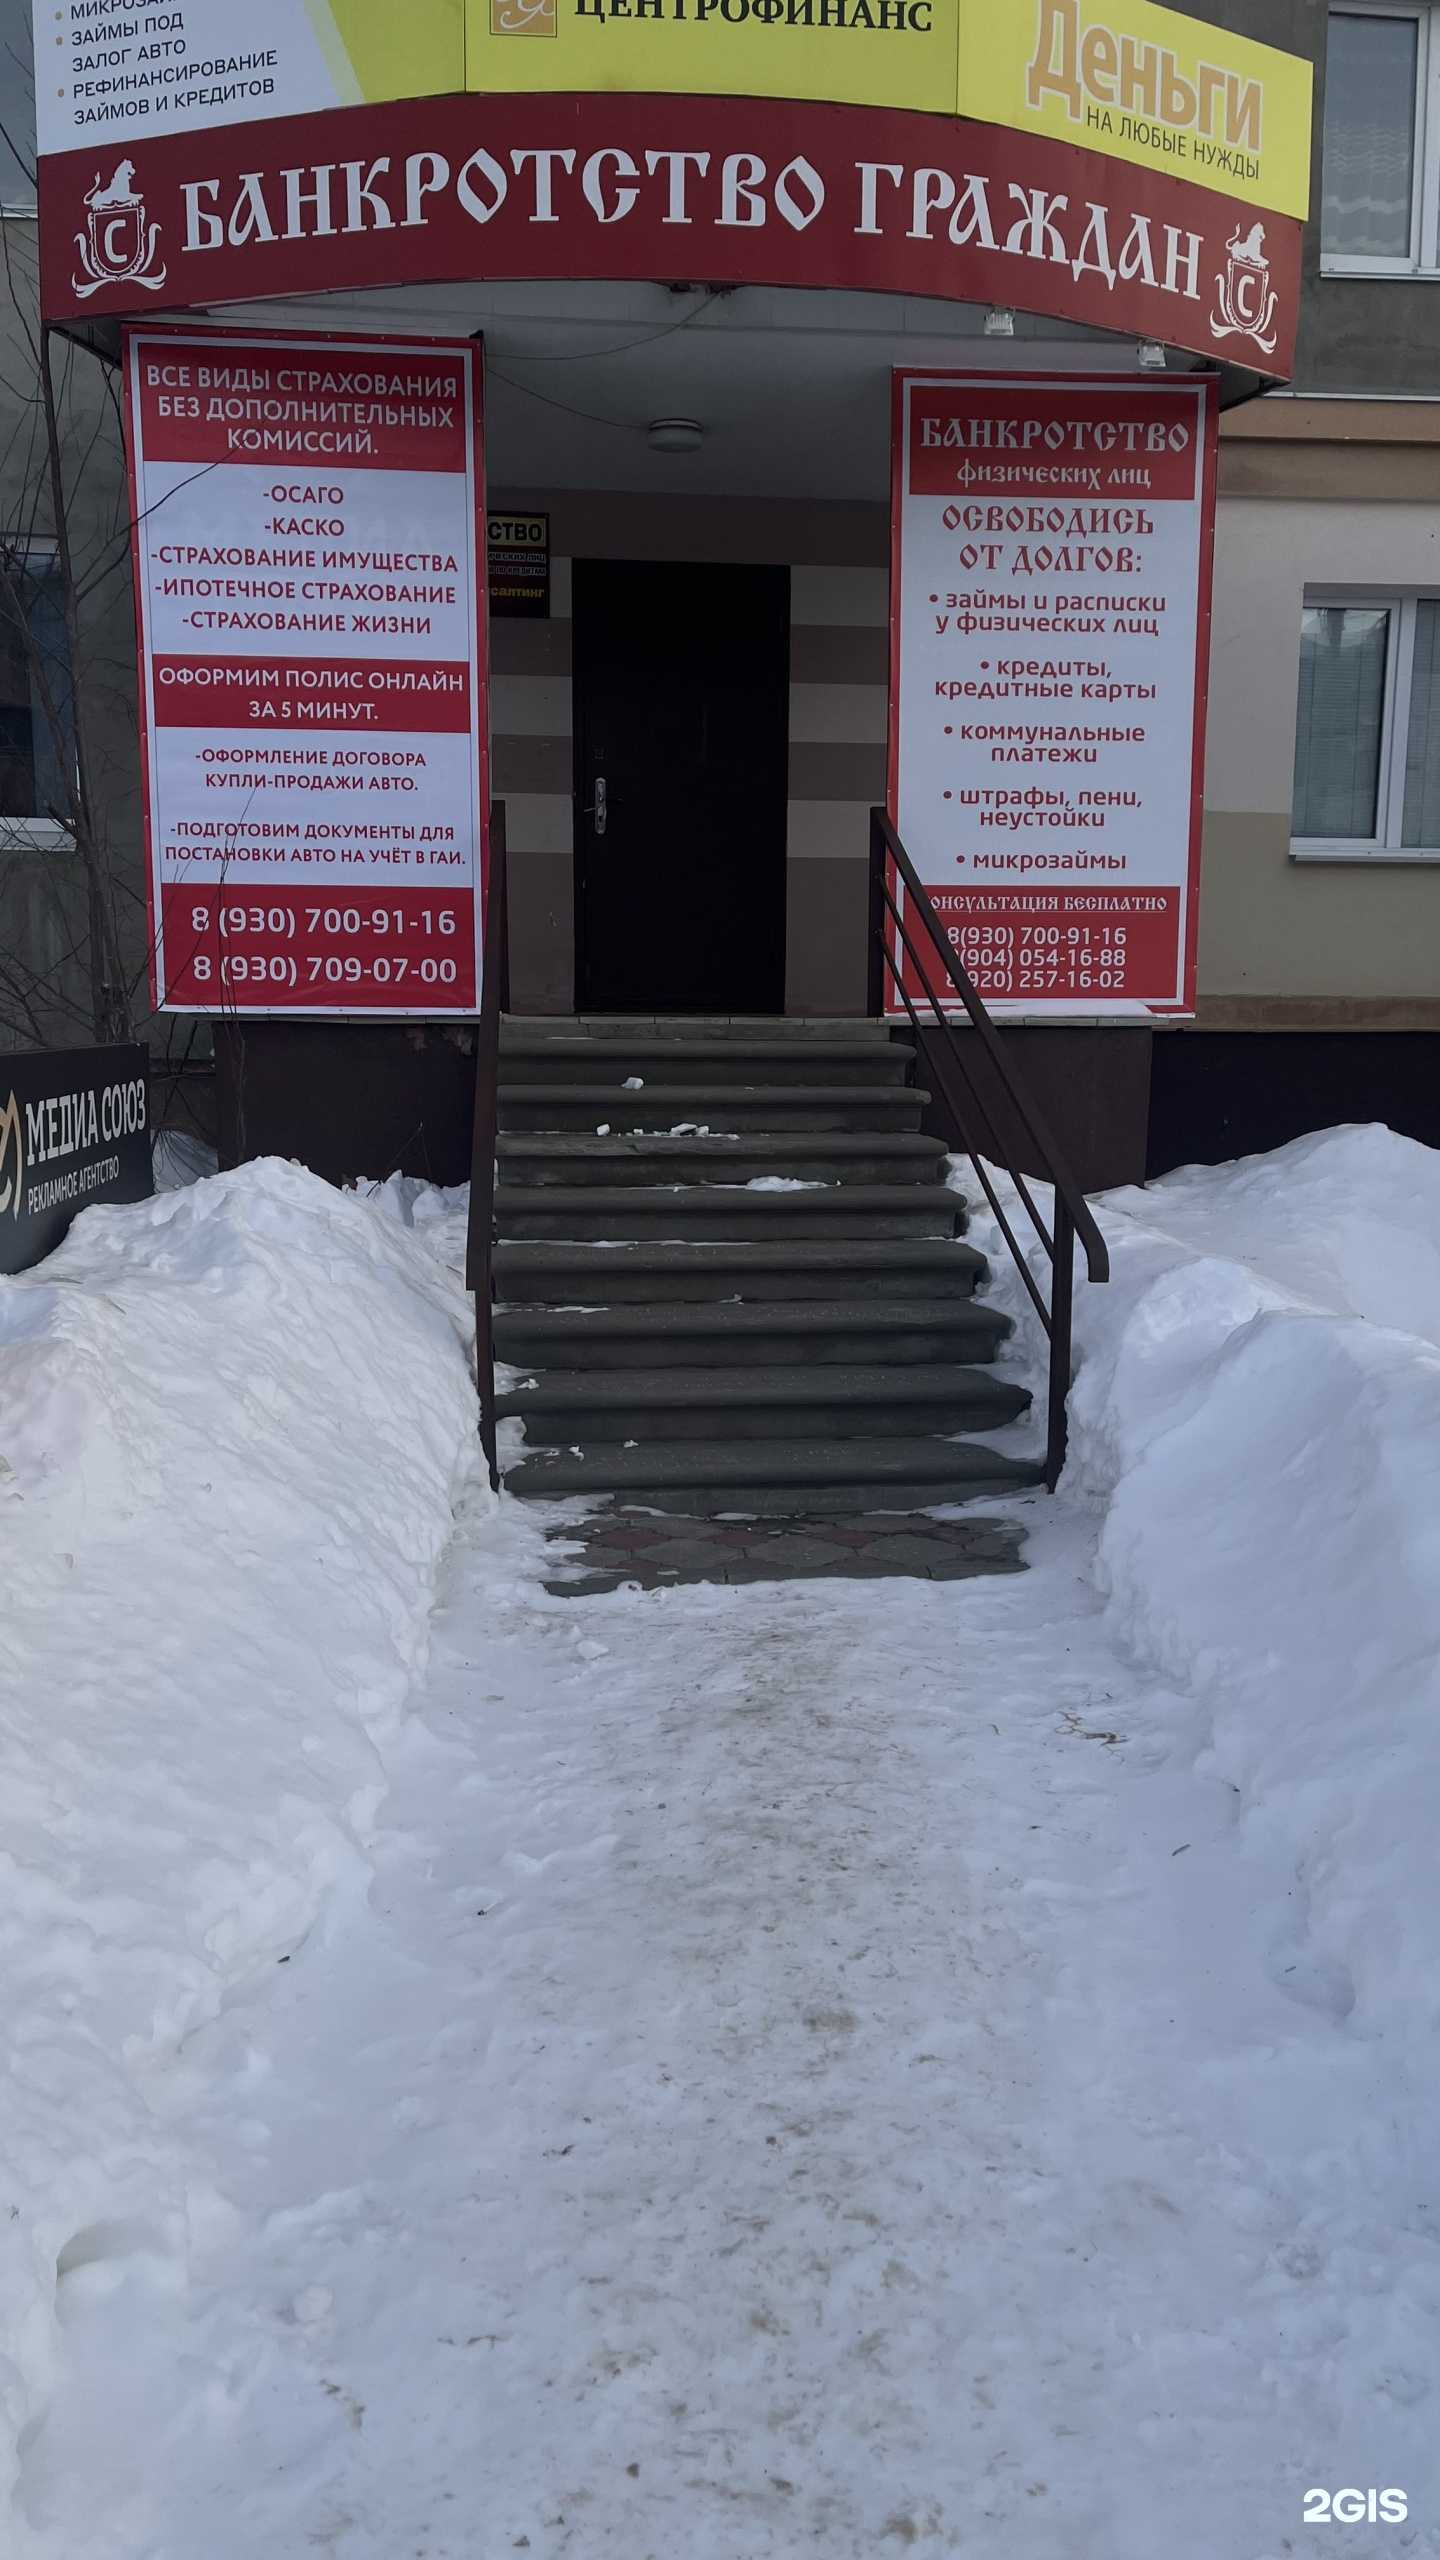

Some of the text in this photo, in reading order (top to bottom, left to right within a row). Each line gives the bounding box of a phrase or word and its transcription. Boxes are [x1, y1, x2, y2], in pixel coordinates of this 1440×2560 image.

[575, 0, 933, 31] ЦЕНТРОФИНАНС
[71, 12, 184, 46] ЗАЙМЫ ПОД
[72, 39, 187, 73] ЗАЛОГ АВТО
[73, 50, 278, 98] РЕФИНАНСИРОВАНИЕ
[1027, 0, 1261, 152] Деньги
[74, 78, 275, 125] ЗАЙМОВ И КРЕДИТОВ
[1087, 105, 1259, 180] НА ЛЮБЫЕ НУЖДЫ
[180, 147, 1204, 300] БАНКРОТСТВО ГРАЖДАН
[146, 366, 457, 398] ВСЕ ВИДЫ СТРАХОВАНИЯ
[158, 396, 454, 428] БЕЗ ДОПОЛНИТЕЛЬНЫХ
[228, 429, 379, 454] КОМИССИЙ.
[921, 418, 1189, 452] БАНКРОТСТВО
[957, 458, 1151, 489] физических лиц
[263, 486, 344, 504] -ОСАГО
[264, 519, 345, 536] -КАСКО
[942, 504, 1154, 538] ОСВОБОДИСЬ
[151, 547, 458, 576] -СТРАХОВАНИЕ ИМУЩЕСТВА
[959, 544, 1141, 576] ОТ ДОЛГОВ:
[155, 579, 456, 603] -ИПОТЕЧНОЕ СТРАХОВАНИЕ
[945, 589, 1166, 614] займы и расписки
[182, 612, 431, 634] -СТРАХОВАНИЕ ЖИЗНИ
[935, 612, 1159, 637] у физических лиц
[159, 667, 463, 691] ОФОРМИМ ПОЛИС ОНЛАЙН
[998, 660, 1112, 679] кредиты,
[935, 681, 1156, 701] кредитные карты
[249, 701, 378, 720] ЗА 5 МИНУТ.
[961, 724, 1145, 744] коммунальные
[195, 749, 426, 769] -ОФОРМЛЕНИЕ ДОГОВОРА
[991, 747, 1097, 763] платежи
[205, 774, 418, 793] КУПЛИ-ПРОДАЖИ АВТО.
[960, 787, 1142, 808] штрафы, пени,
[979, 808, 1105, 830] неустойки
[170, 822, 454, 843] -ПОДГОТОВИМ ДОКУМЕНТЫ ДЛЯ
[165, 845, 466, 865] ПОСТАНОВКИ АВТО НА УЧЁТ В ГАИ.
[973, 850, 1127, 872] микрозаймы
[930, 895, 1168, 913] ОНСУЛЬТАЦИЯ БЕСПЛАТНО
[192, 906, 456, 938] 8 (930) 700-91-16
[947, 927, 1126, 947] 8(930) 700-91-16
[193, 956, 457, 986] 8 (930) 709-07-00
[954, 949, 1126, 968] (904) 054-16-88
[1020, 971, 1125, 988] 257-16-02
[26, 1079, 146, 1166] МЕДИА СОЮЗ
[28, 1155, 119, 1216] РЕКЛАМНОЕ АГЕНТСТВО
